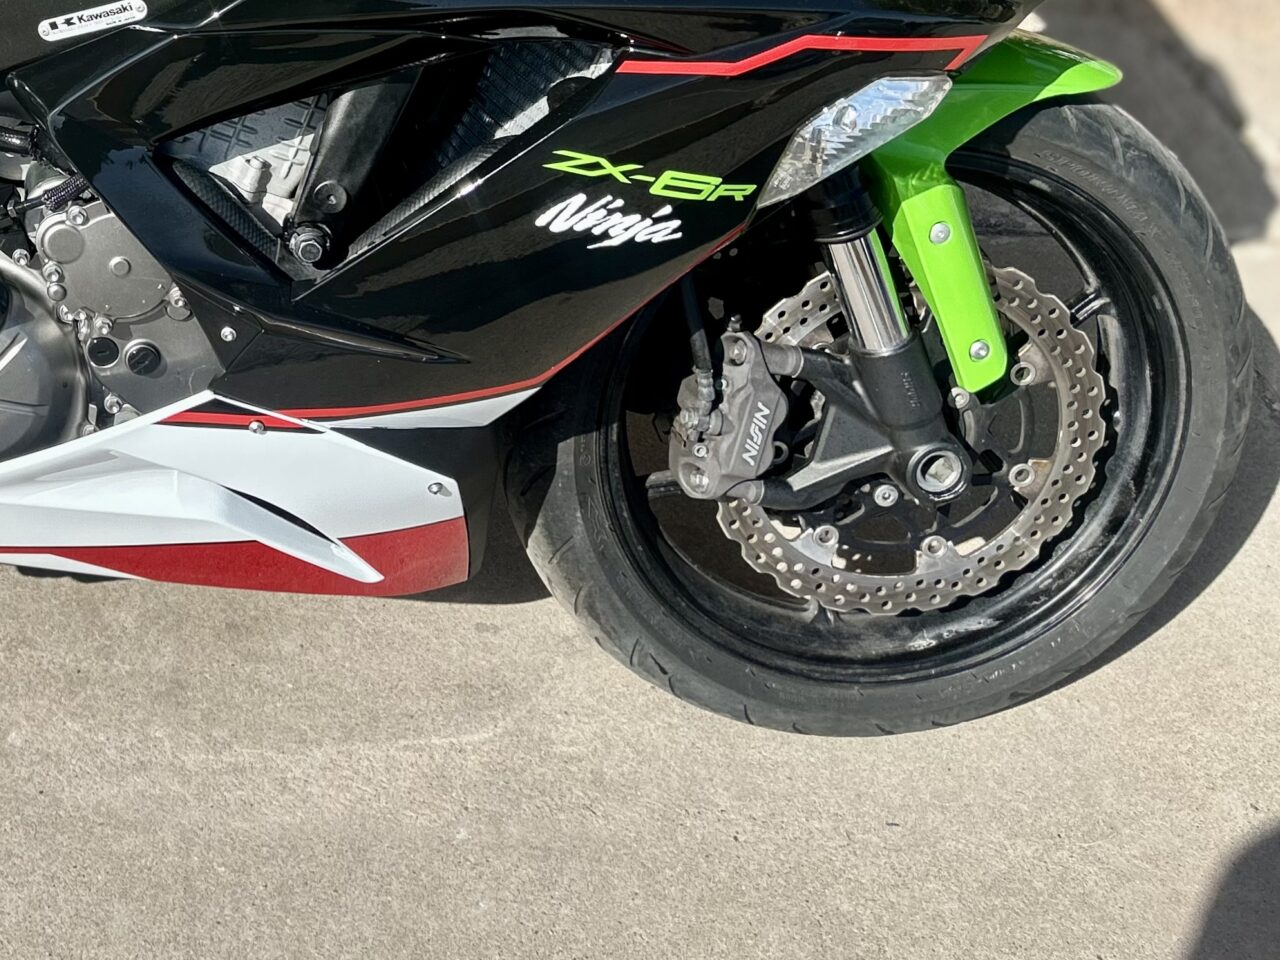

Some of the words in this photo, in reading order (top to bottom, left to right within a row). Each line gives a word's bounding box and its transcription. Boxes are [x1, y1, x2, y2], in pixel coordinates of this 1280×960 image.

[76, 1, 134, 24] Kawasaki
[542, 149, 758, 202] ZX-6R
[534, 192, 684, 250] Ninja
[742, 401, 771, 467] NISSIN
